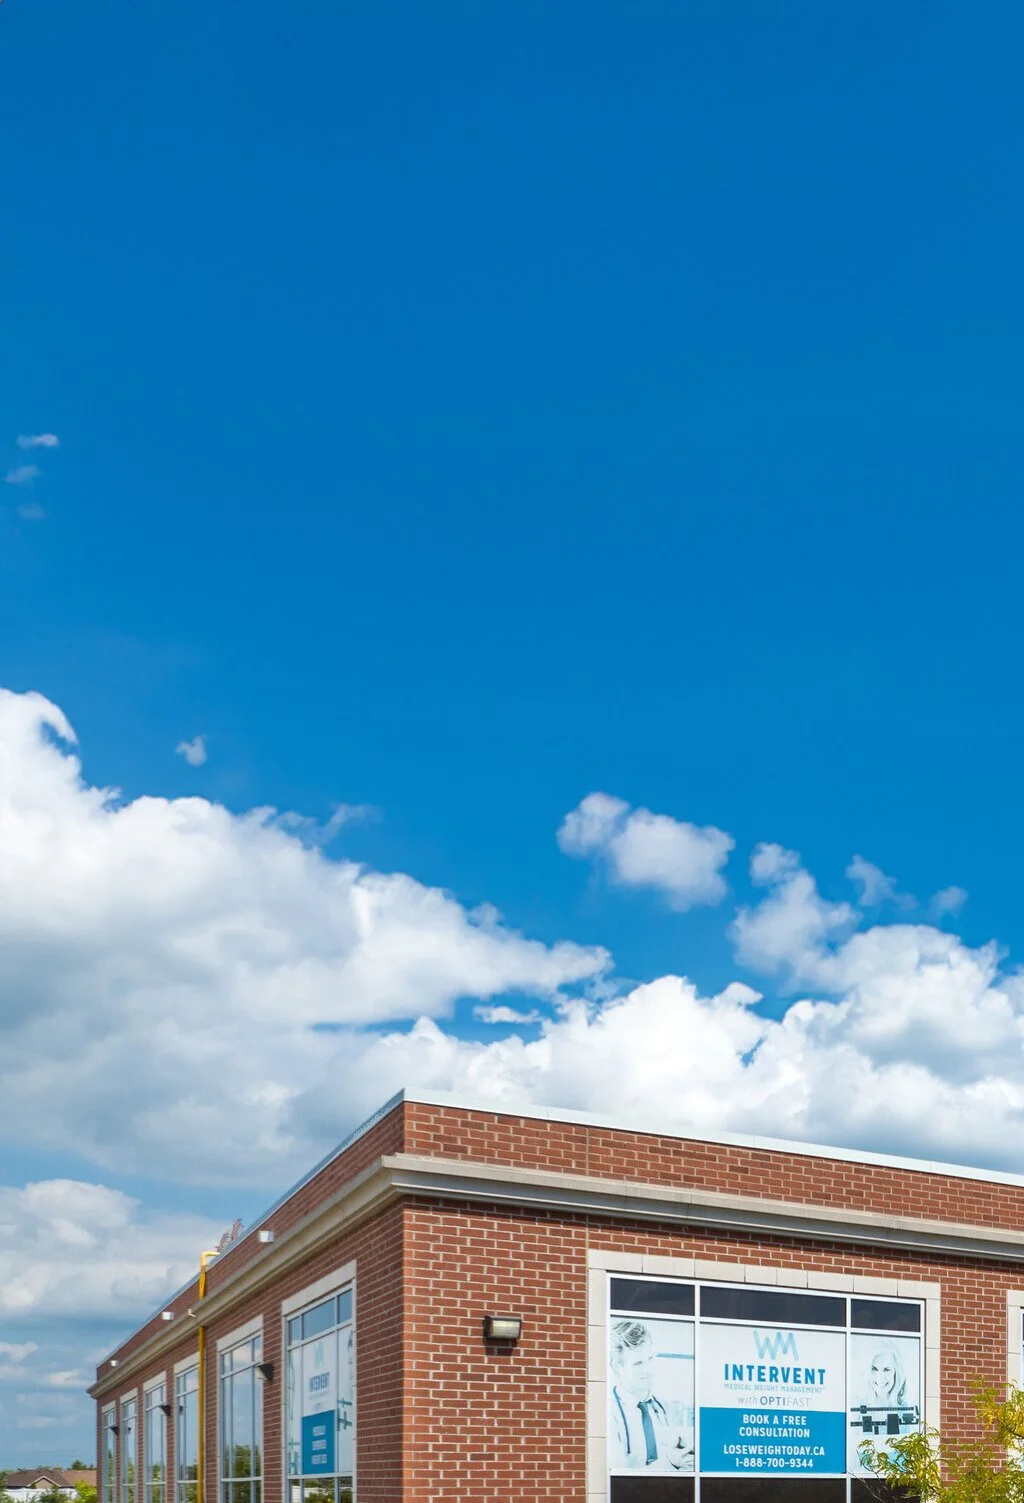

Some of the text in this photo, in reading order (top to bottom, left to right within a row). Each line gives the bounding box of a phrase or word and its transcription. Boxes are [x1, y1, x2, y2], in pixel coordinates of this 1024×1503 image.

[724, 1363, 826, 1385] INTERVENT
[724, 1383, 751, 1391] MEDICAL
[754, 1384, 778, 1392] WEIGHT
[738, 1394, 811, 1407] with OPTIFAST
[743, 1414, 807, 1426] BOOK A FREE
[739, 1426, 810, 1438] CONSULTATION
[723, 1444, 825, 1456] LOSEWEIGHTODAY.CA
[735, 1457, 814, 1468] 1-888-700-9344
